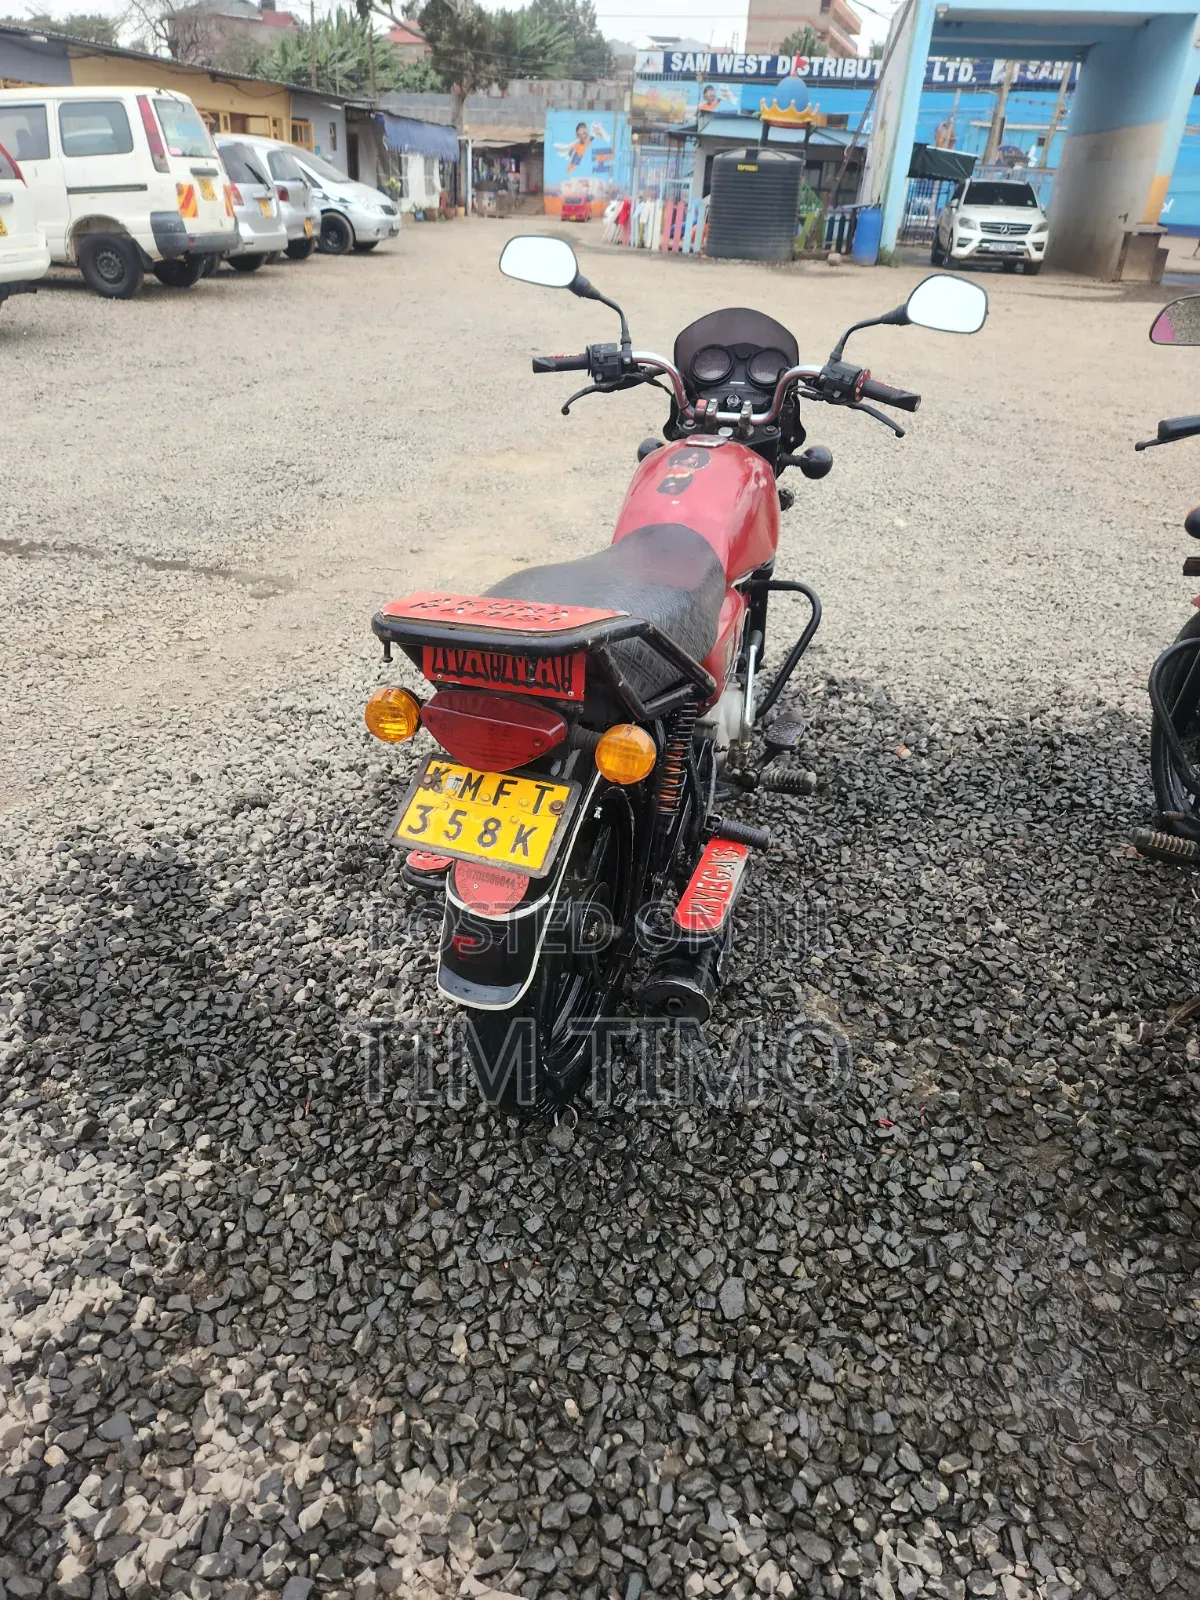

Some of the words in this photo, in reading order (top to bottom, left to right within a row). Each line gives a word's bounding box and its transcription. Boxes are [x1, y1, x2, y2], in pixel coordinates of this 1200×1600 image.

[670, 52, 711, 72] SAM
[716, 54, 771, 75] WEST
[406, 804, 539, 858] 358K
